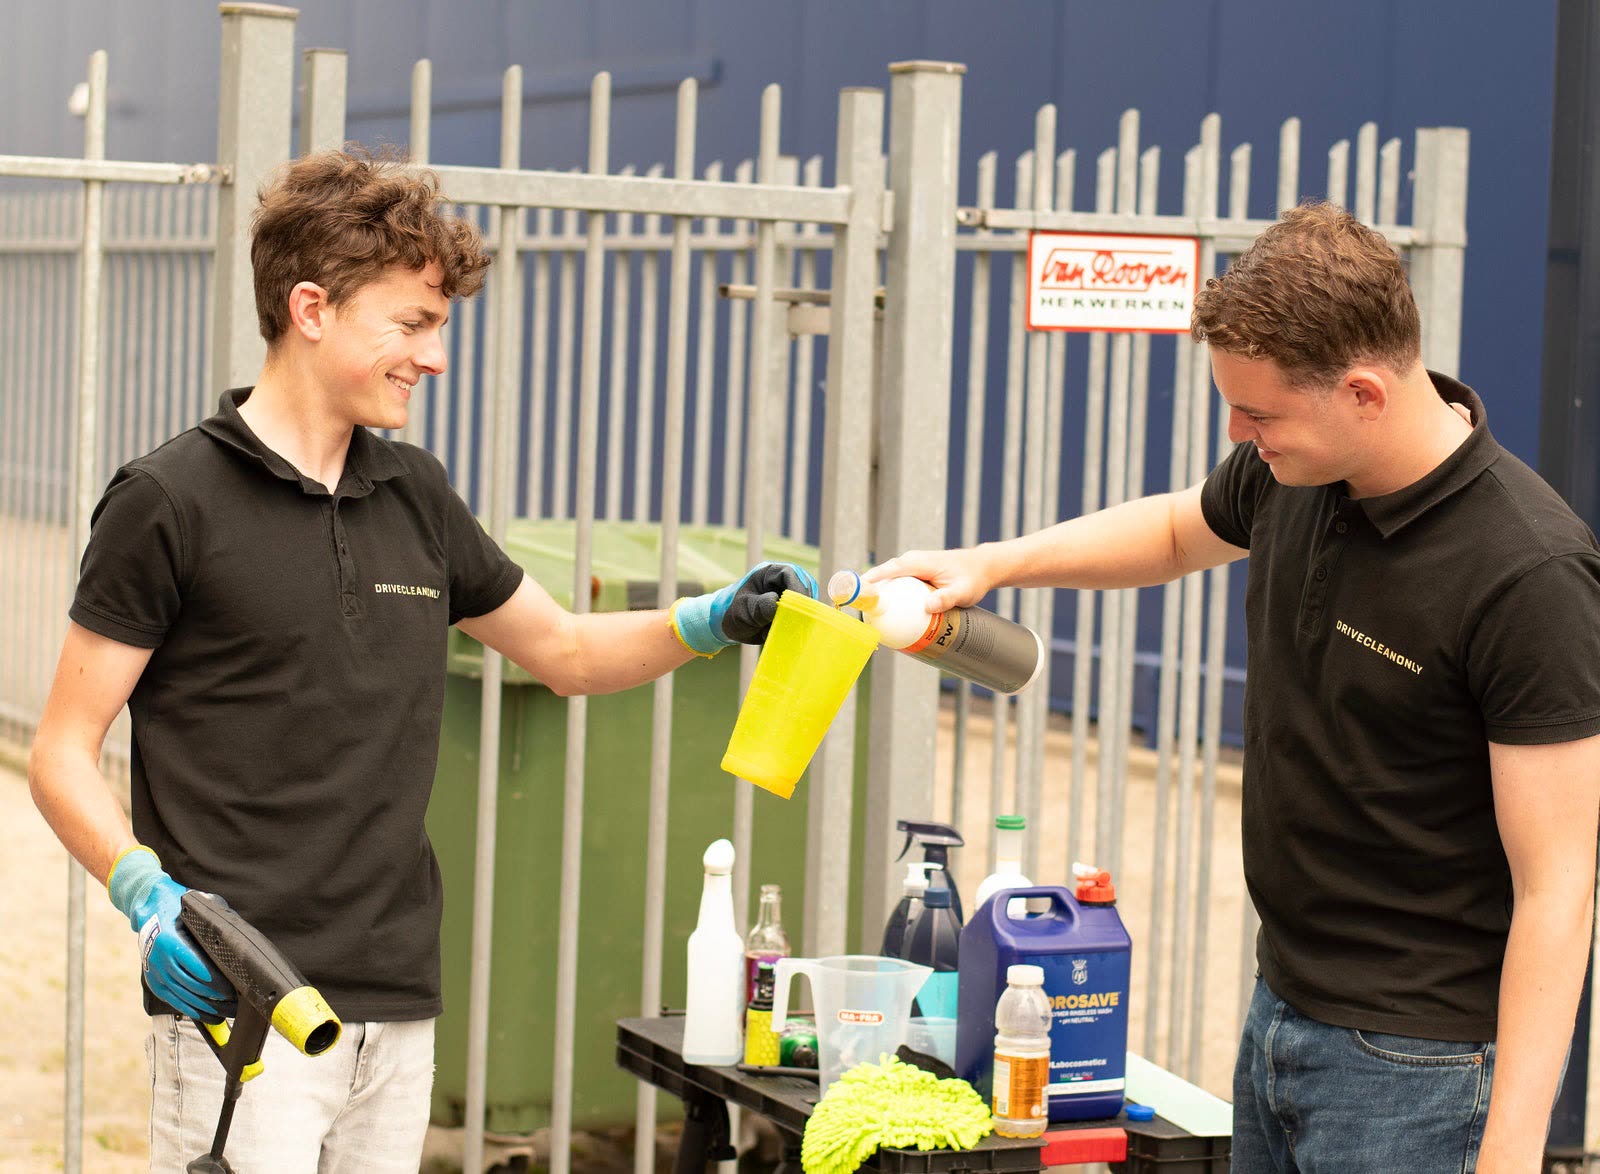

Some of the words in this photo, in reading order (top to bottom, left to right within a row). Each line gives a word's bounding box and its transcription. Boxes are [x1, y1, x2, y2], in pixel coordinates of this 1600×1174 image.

[1040, 296, 1185, 310] HEKWERKEN
[936, 623, 954, 647] Pw
[1336, 620, 1423, 675] DRIVECLEANONLY
[1048, 992, 1119, 1010] DROSAVE
